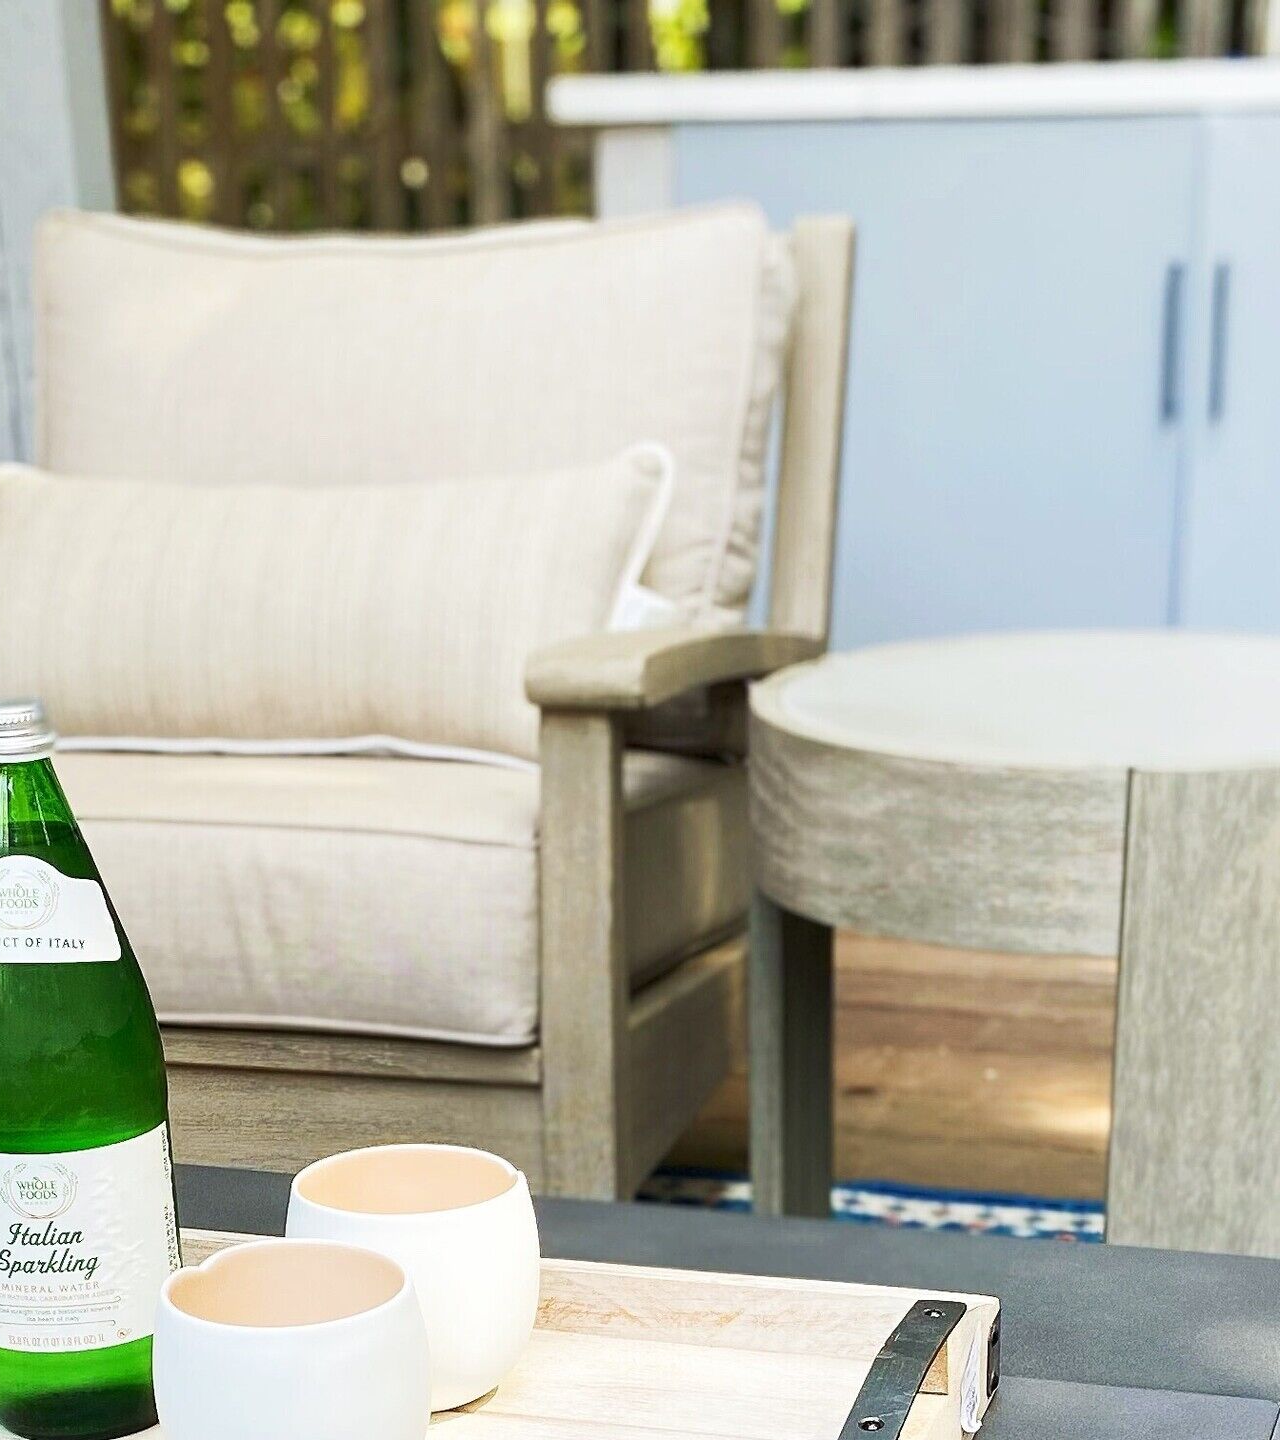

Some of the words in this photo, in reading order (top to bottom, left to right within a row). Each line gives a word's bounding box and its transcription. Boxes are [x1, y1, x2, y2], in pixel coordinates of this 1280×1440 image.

[0, 898, 39, 909] FOODS
[25, 937, 43, 948] OF
[48, 938, 86, 950] ITALY
[16, 1179, 56, 1191] WHOLE
[20, 1190, 58, 1200] FOODS
[7, 1220, 84, 1247] Italian
[1, 1283, 53, 1294] MINERAL
[59, 1281, 100, 1293] WATER
